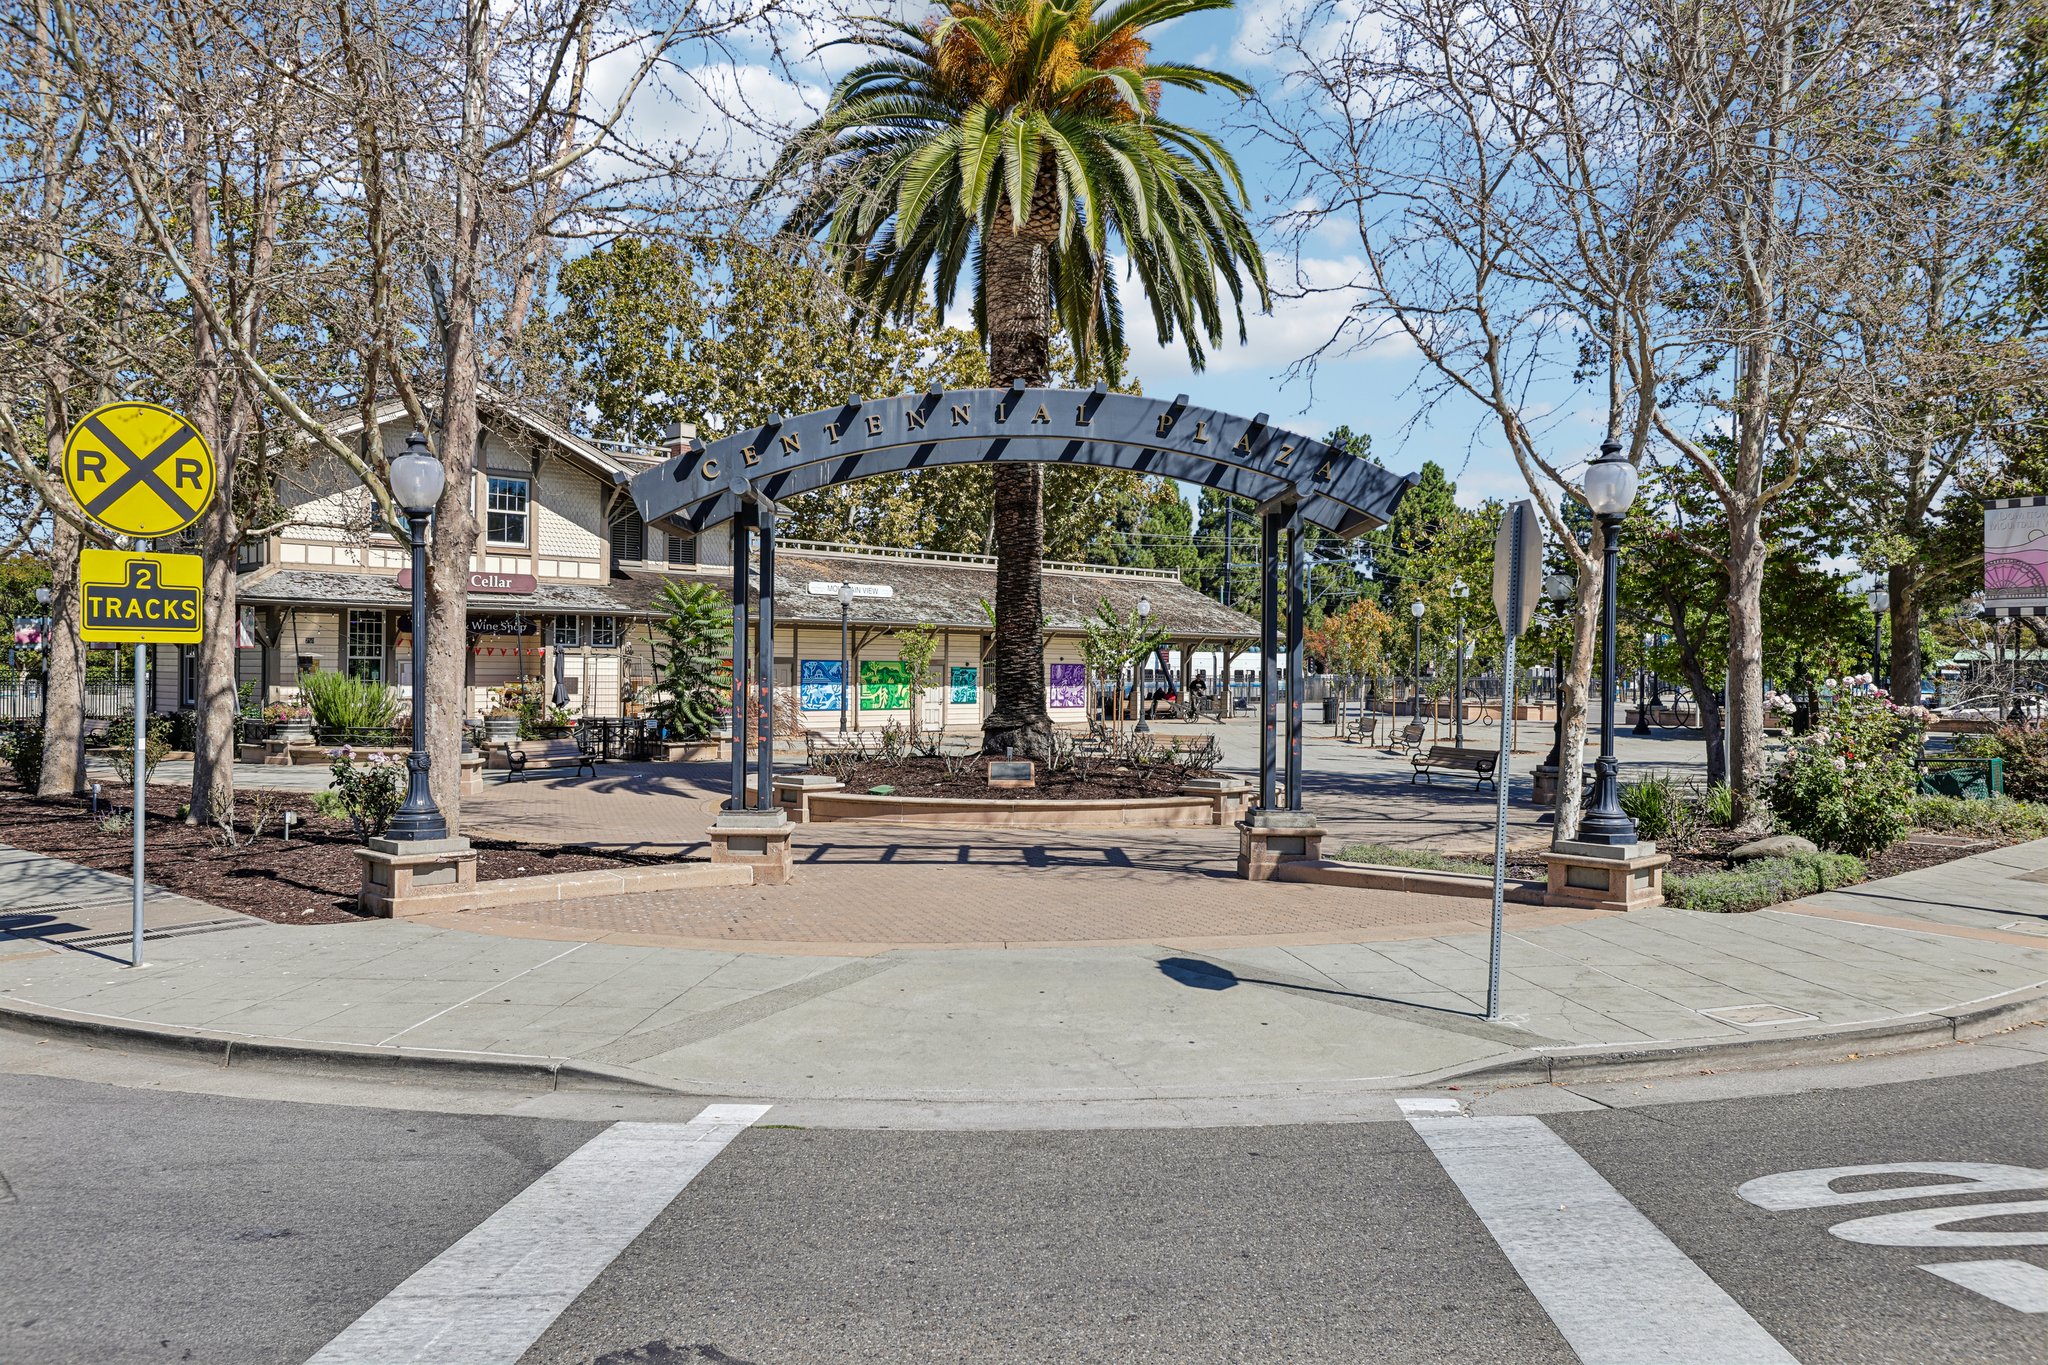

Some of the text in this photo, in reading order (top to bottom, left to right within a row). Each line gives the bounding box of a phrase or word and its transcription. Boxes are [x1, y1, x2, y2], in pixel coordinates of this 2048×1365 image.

[702, 402, 1332, 480] CENTENNIAL PLAZA
[77, 449, 203, 490] R R
[135, 568, 152, 590] 2
[471, 574, 512, 588] Cellar
[827, 584, 861, 593] MOAIN
[862, 587, 879, 595] VIEW
[88, 596, 196, 621] TRACKS
[471, 619, 498, 631] Wine
[500, 620, 527, 633] Shop
